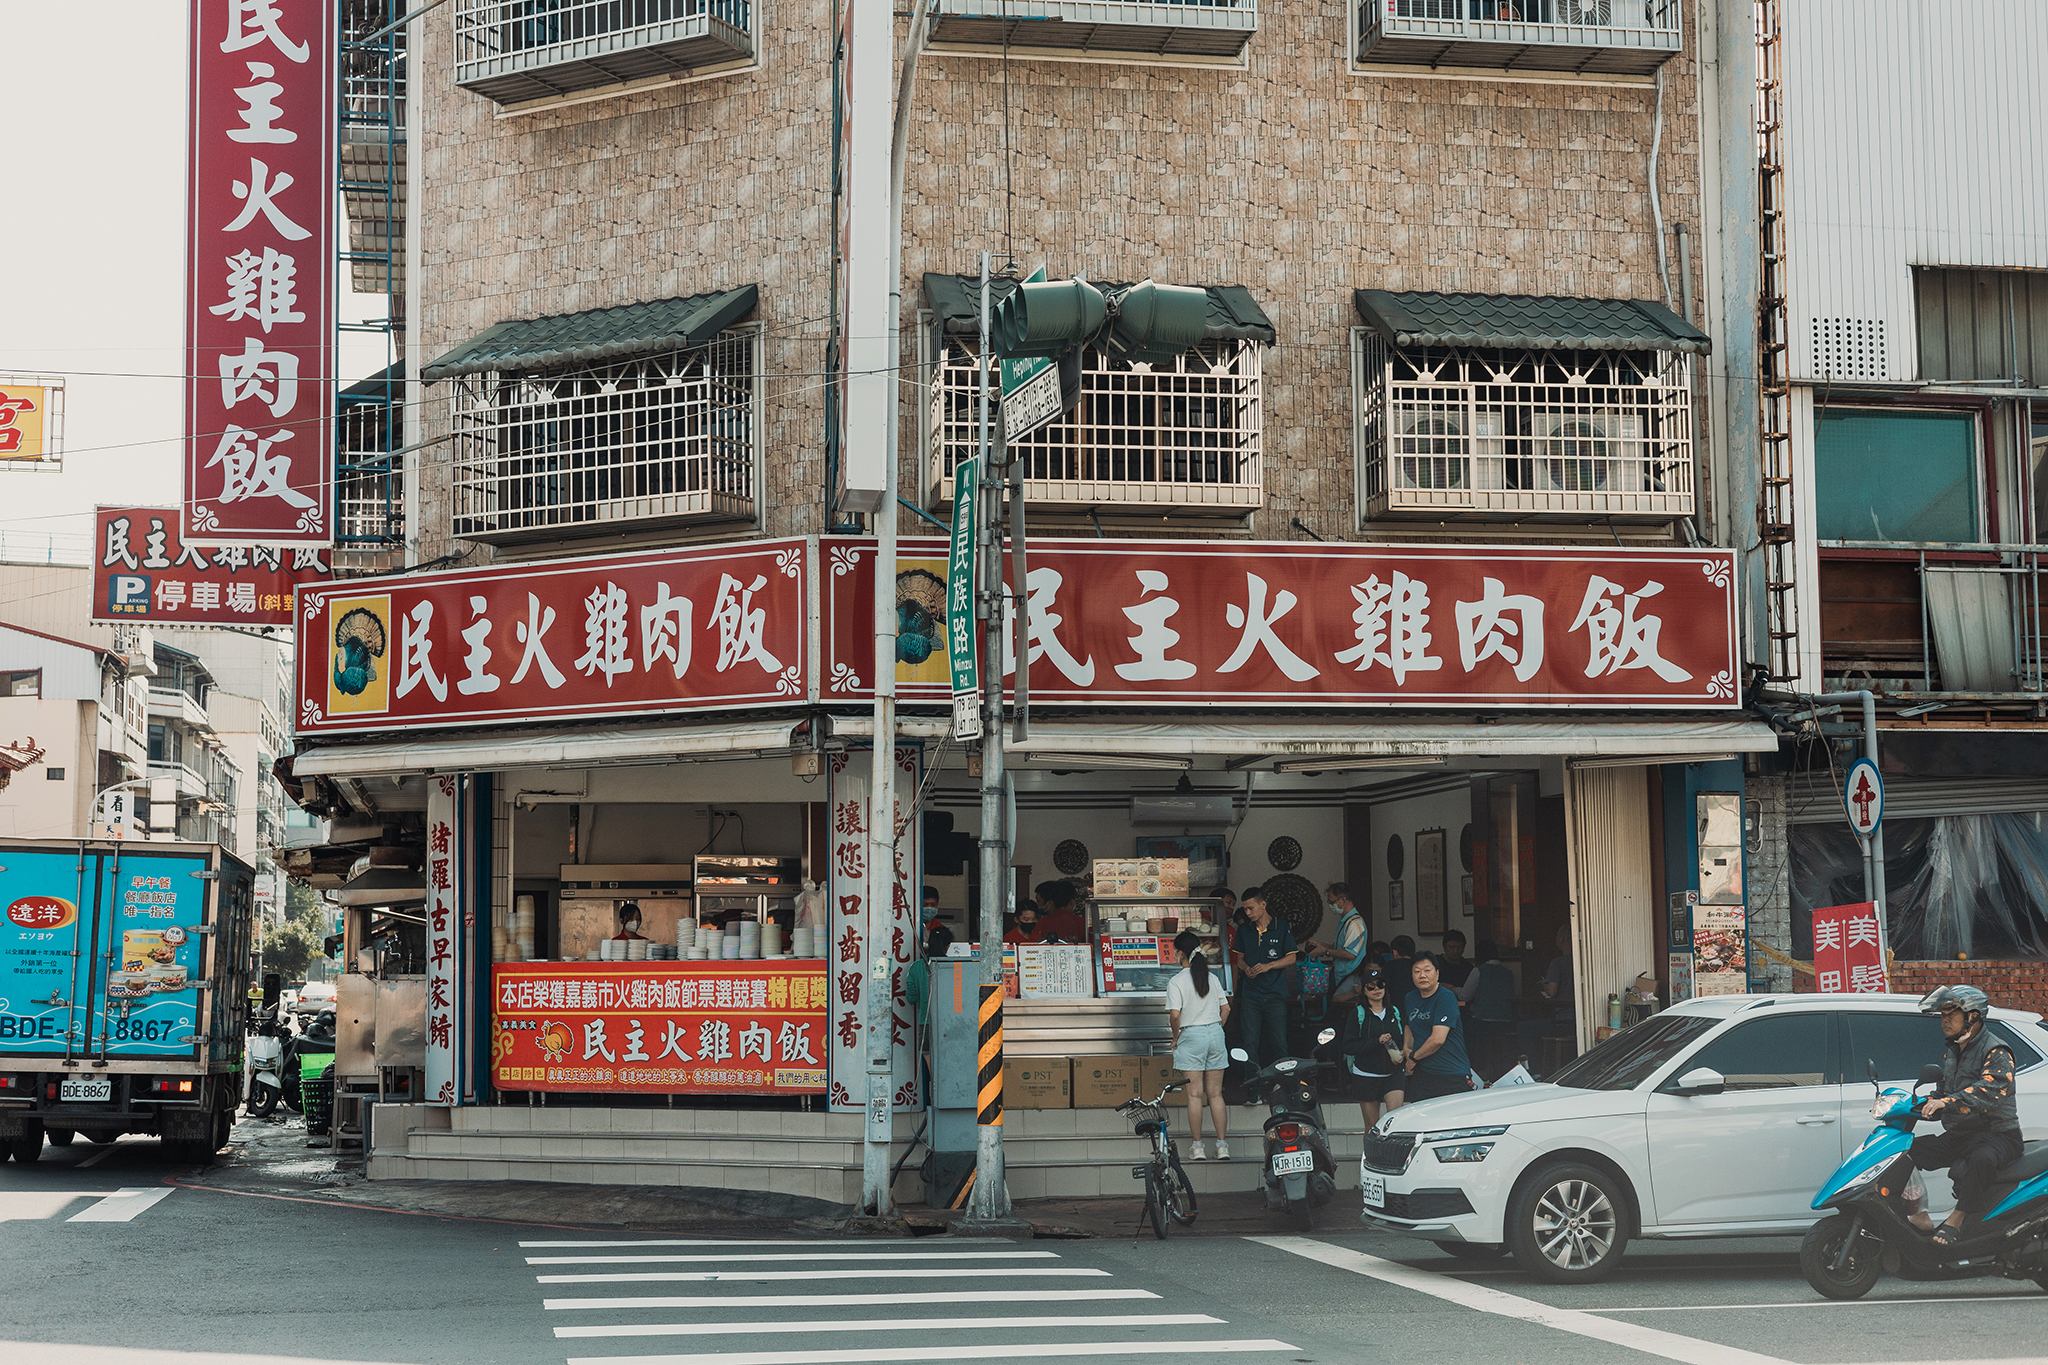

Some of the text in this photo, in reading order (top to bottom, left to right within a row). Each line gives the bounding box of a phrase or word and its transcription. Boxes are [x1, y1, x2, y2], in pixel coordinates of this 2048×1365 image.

[204, 0, 319, 509] 民主火雞肉飯
[154, 579, 256, 613] 停車場
[953, 531, 968, 655] 民族路
[112, 604, 147, 614] 停車場
[1002, 567, 1694, 687] 民主火雞肉飯
[396, 573, 784, 702] 民主火雞肉飯
[954, 658, 972, 672] Minzu
[959, 673, 970, 688] Rd.
[131, 876, 171, 889] 早午餐
[124, 891, 177, 904] 餐廳飯店
[11, 904, 61, 923] 遠洋
[124, 906, 175, 919] 唯一指名
[835, 800, 867, 1049] 讓您口齒留香
[430, 821, 452, 1049] 諸羅古早家餚
[1848, 914, 1885, 993] 美髮
[115, 1019, 174, 1042] 8867
[501, 1019, 537, 1031] 嘉義美食
[582, 1018, 819, 1064] 民主火雞肉飯
[500, 1068, 545, 1080] 本店特色
[1034, 1071, 1053, 1080] PST
[1105, 1069, 1124, 1079] PST
